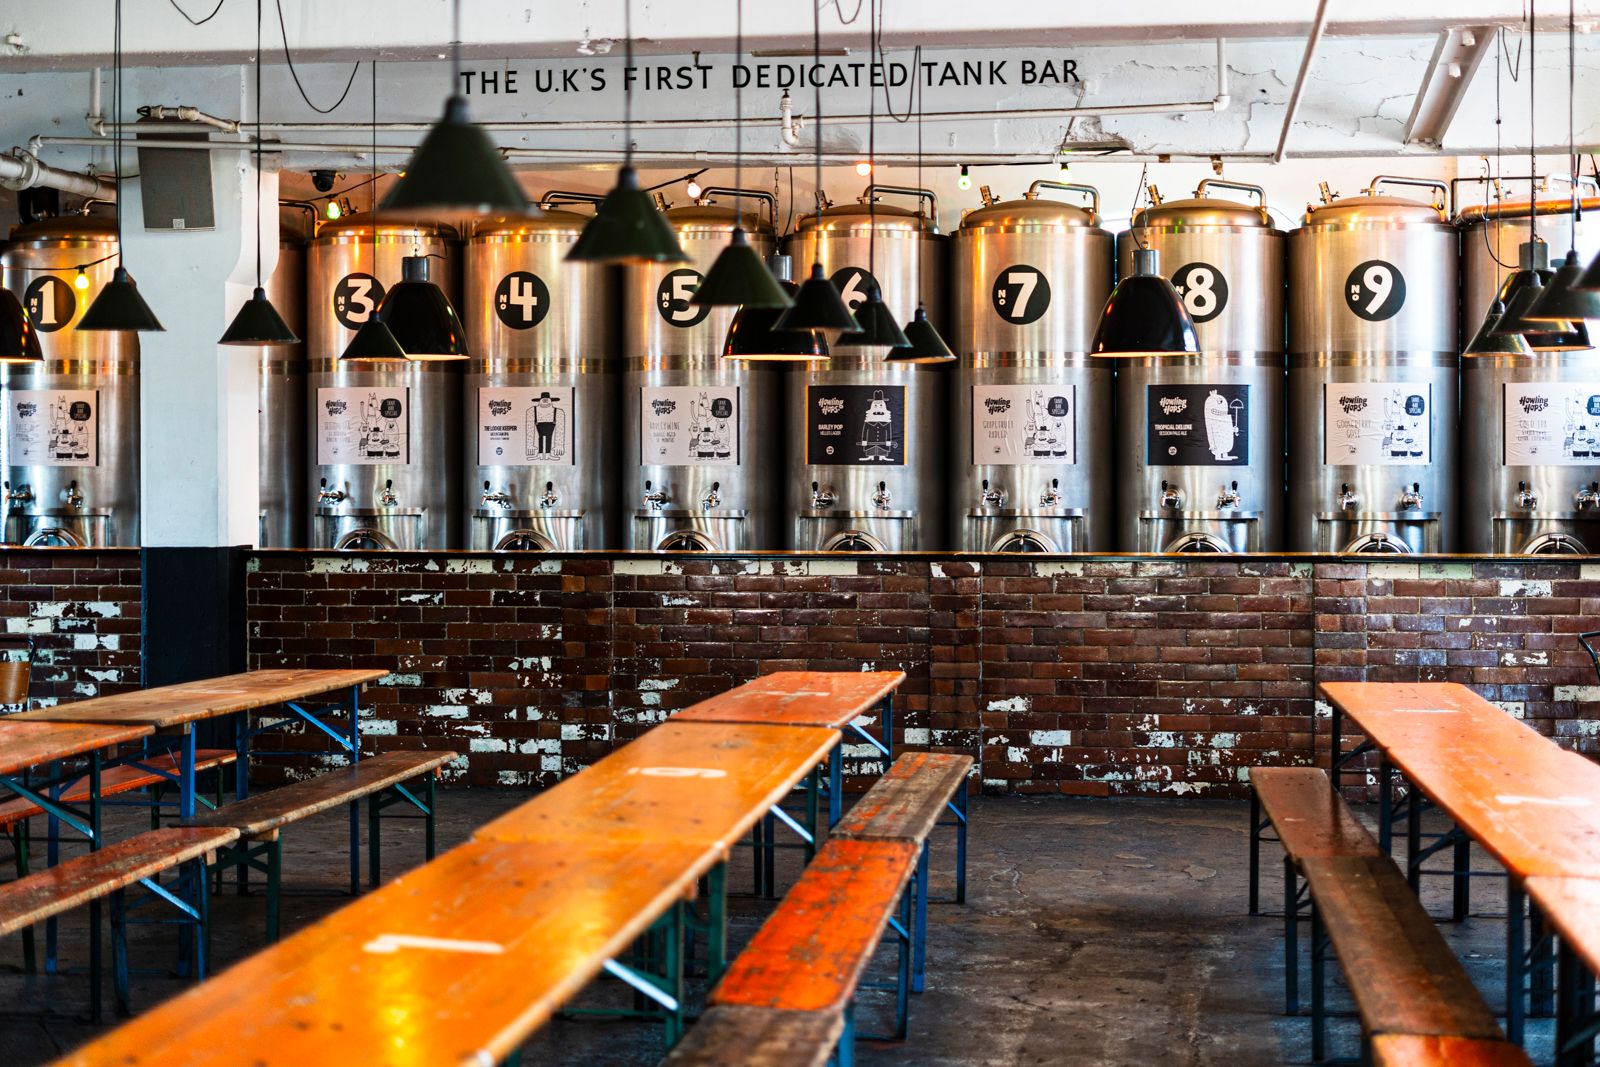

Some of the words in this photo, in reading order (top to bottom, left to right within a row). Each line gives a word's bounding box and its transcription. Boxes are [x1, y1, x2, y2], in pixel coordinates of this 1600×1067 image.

[460, 70, 518, 95] THE
[535, 67, 606, 93] U.K'S
[624, 65, 713, 91] FIRST
[732, 63, 908, 88] DEDICATED
[921, 61, 1007, 86] TANK
[1021, 59, 1079, 84] BAR
[38, 280, 58, 325] 1
[346, 278, 375, 323] 3
[509, 276, 537, 321] 4
[672, 275, 700, 321] 5
[1008, 272, 1038, 318] 7
[1184, 267, 1217, 316] 8
[1363, 265, 1393, 315] 9
[489, 399, 512, 410] Howling
[652, 399, 676, 410] Howling
[818, 397, 844, 409] Howling
[985, 397, 1011, 408] Howling
[1160, 397, 1187, 408] Howling
[1339, 396, 1367, 407] Howling
[1519, 395, 1548, 407] Howling
